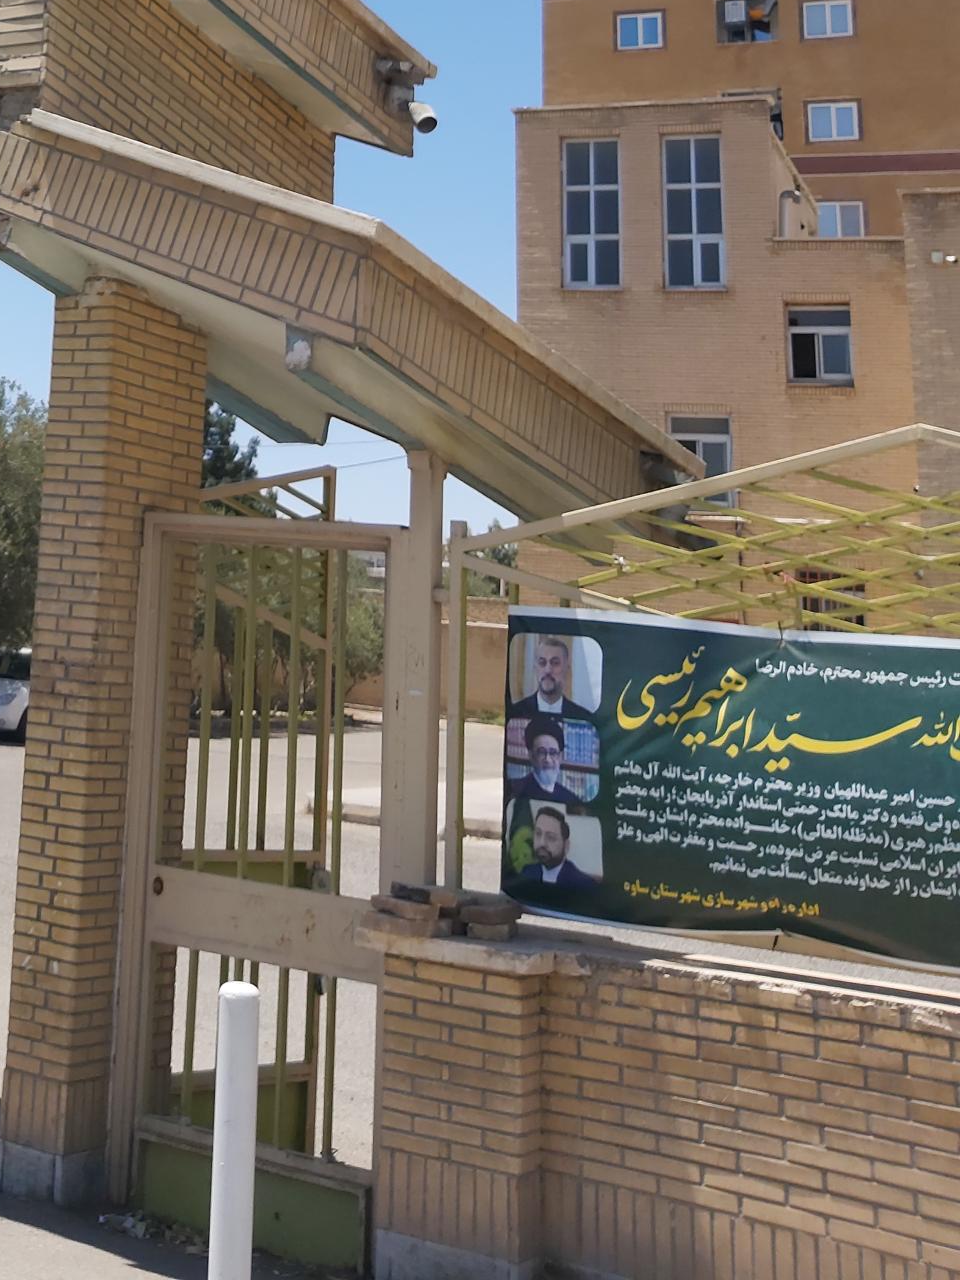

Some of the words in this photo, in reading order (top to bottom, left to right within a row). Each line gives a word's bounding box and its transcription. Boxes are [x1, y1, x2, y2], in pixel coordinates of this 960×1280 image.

[754, 657, 787, 678] الرضا
[786, 662, 818, 682] خادم
[861, 670, 908, 686] جمهور
[909, 669, 947, 689] رئیس
[616, 645, 707, 731] رئیسی
[672, 666, 757, 758] ابراهیم
[614, 759, 643, 777] هاشم
[643, 761, 660, 780] آل
[682, 766, 707, 785] آیت
[615, 781, 648, 799] محضر
[753, 775, 793, 793] محترم
[794, 780, 821, 798] وزیر
[823, 781, 889, 804] عبداللهیان
[736, 794, 782, 812] استاندار
[889, 788, 915, 807] امیر
[916, 794, 957, 809] حسین
[648, 810, 656, 822] و
[656, 806, 689, 823] ایشان
[782, 801, 826, 821] رحمتی
[827, 804, 859, 821] مالک
[860, 807, 889, 825] دکتر
[898, 810, 924, 829] فقیه
[689, 813, 725, 829] محترم
[889, 814, 897, 828] و
[924, 813, 952, 835] ولی
[635, 828, 642, 842] و
[642, 826, 669, 843] الهی
[669, 832, 706, 848] مغفرت
[707, 838, 715, 851] و
[717, 839, 764, 857] رحمت
[890, 837, 934, 856] رهبری
[804, 847, 839, 865] عرض
[839, 850, 879, 868] تسلیت
[879, 854, 926, 872] اسلامی
[746, 866, 767, 878] می
[808, 868, 843, 886] متعال
[623, 879, 650, 896] ساوه
[844, 873, 890, 893] خداوند
[918, 880, 957, 900] ایشان
[790, 901, 820, 918] اداره
